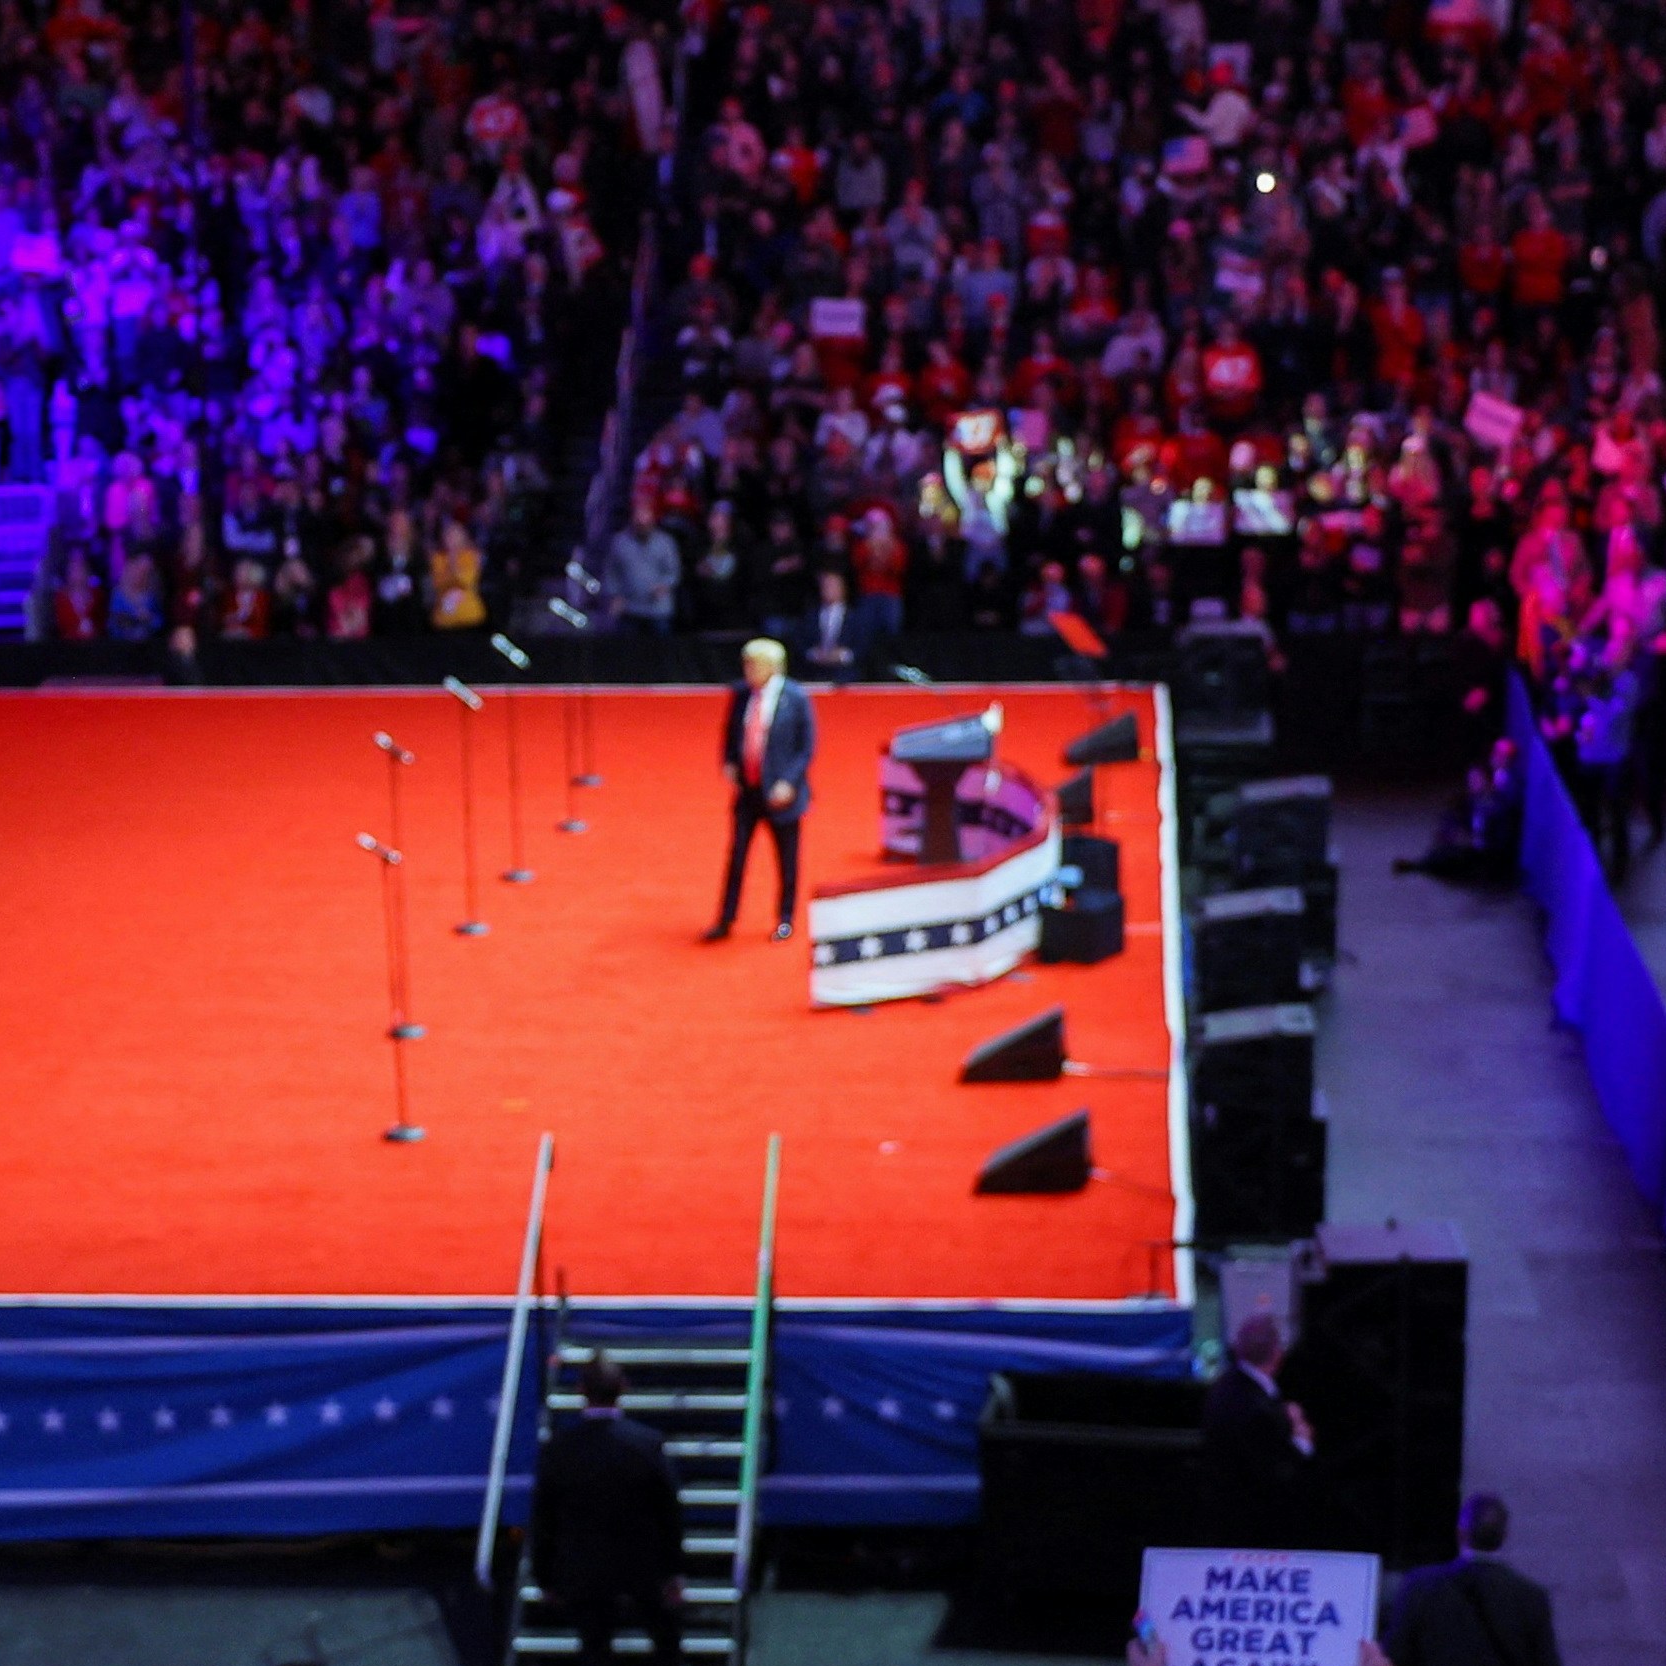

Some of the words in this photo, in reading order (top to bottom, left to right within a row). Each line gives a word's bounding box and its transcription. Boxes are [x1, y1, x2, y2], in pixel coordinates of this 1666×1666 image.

[1206, 1566, 1311, 1594] MAKE
[1172, 1596, 1340, 1625] AMERICA
[1191, 1627, 1316, 1655] GREAT
